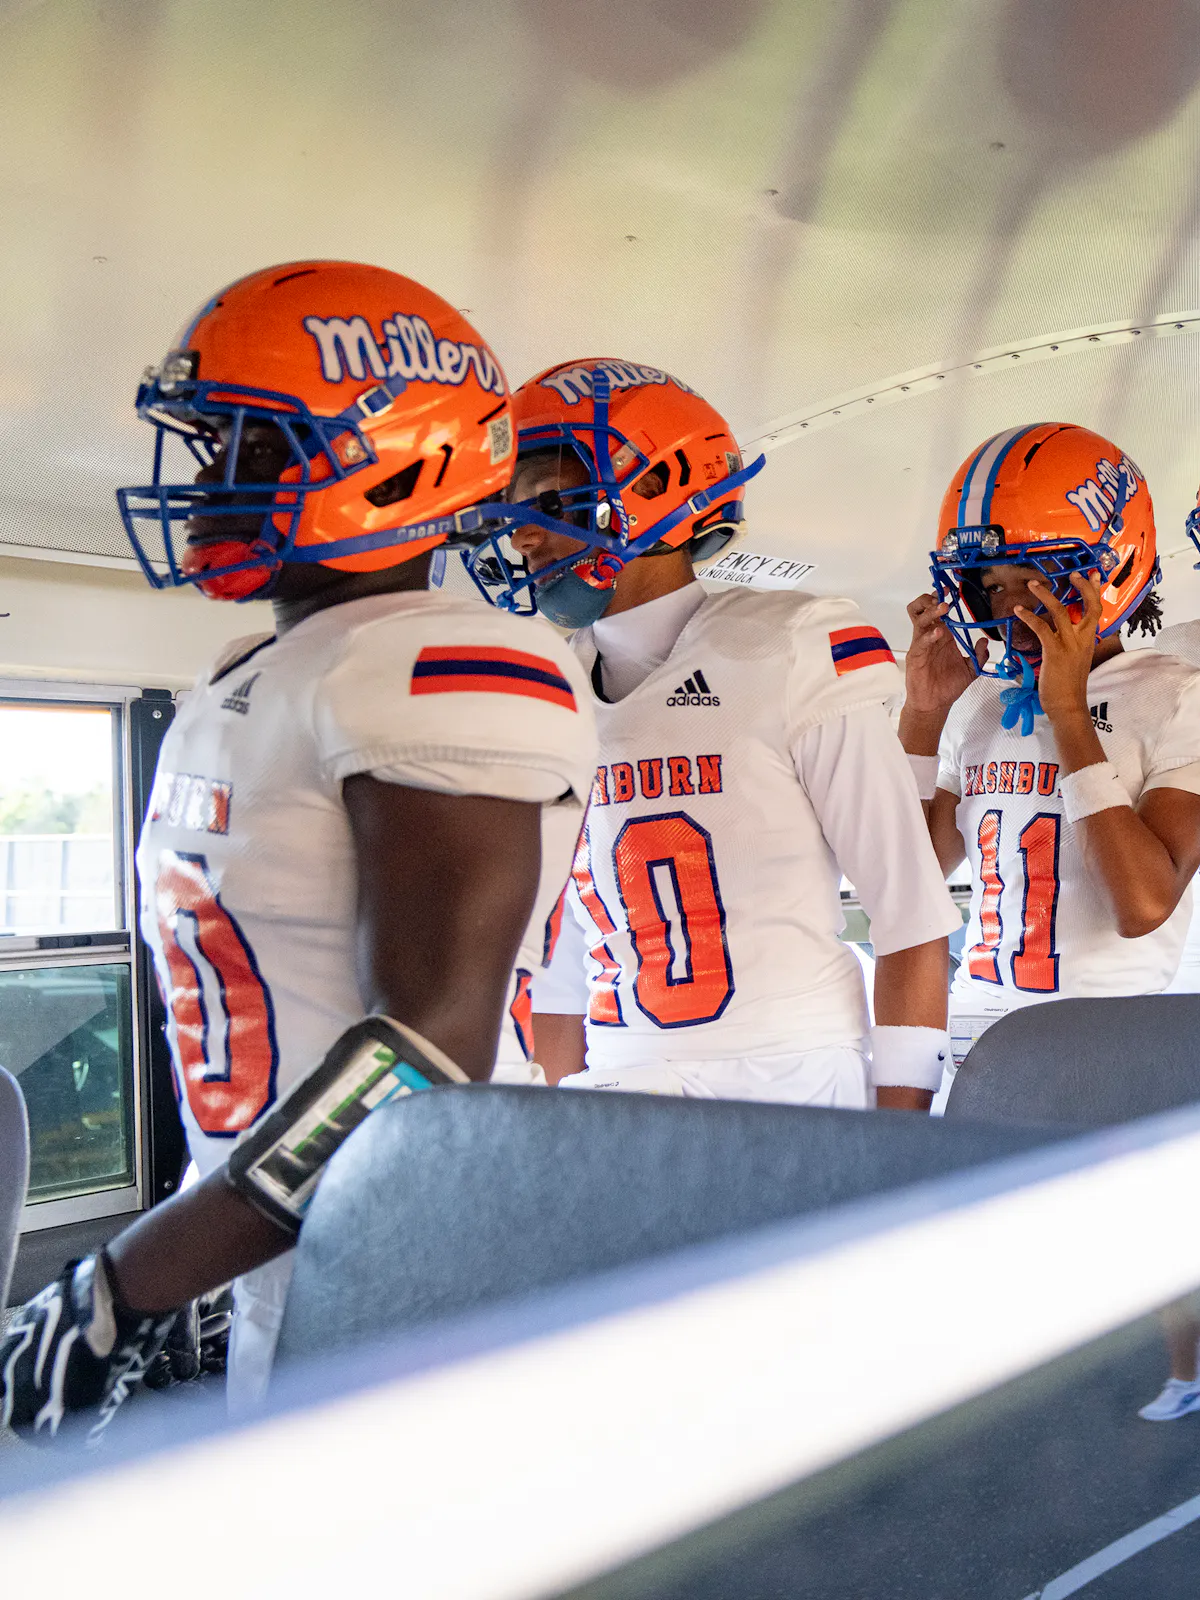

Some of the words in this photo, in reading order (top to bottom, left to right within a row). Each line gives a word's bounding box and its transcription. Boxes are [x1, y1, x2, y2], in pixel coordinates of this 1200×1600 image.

[303, 312, 505, 397] Millers
[958, 530, 982, 544] WIN
[707, 568, 726, 580] NOT
[724, 571, 757, 584] BLOCK
[715, 551, 774, 574] ENCY
[768, 560, 816, 580] EXIT
[666, 693, 721, 707] adidas
[964, 761, 1064, 798] WASHBU
[968, 809, 1061, 994] 11
